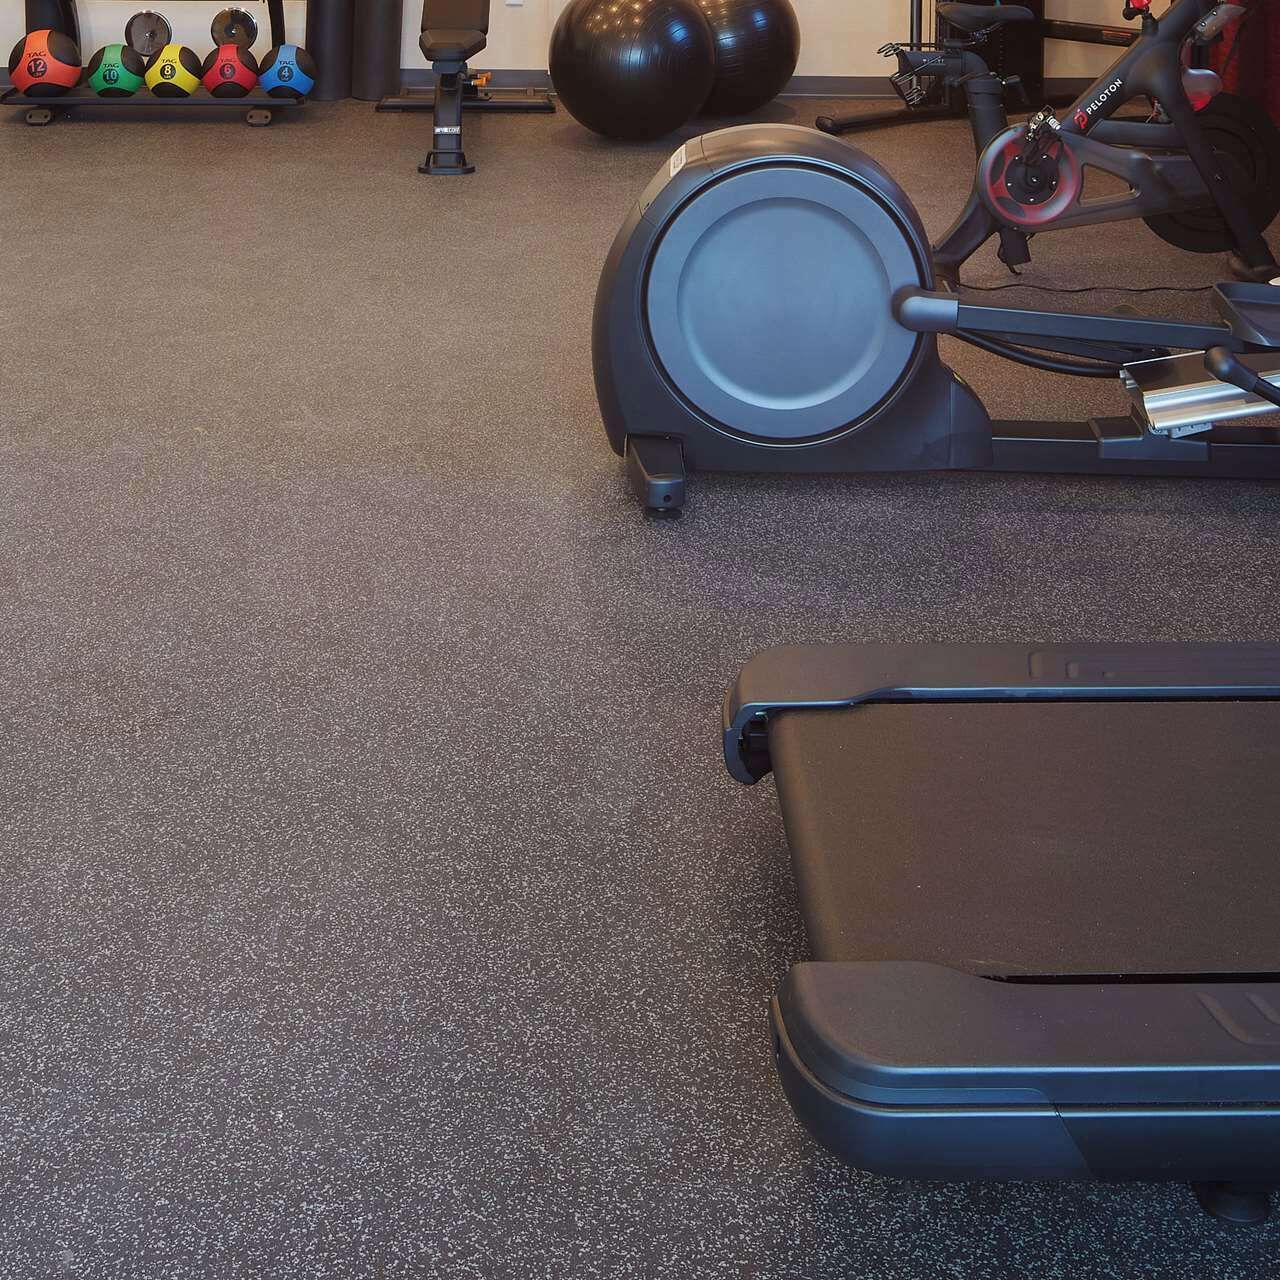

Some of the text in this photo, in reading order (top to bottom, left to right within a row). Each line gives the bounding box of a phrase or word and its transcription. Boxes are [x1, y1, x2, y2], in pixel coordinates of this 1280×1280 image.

[28, 60, 44, 73] 12
[165, 65, 171, 75] 8
[224, 63, 231, 74] 6
[104, 71, 117, 80] 10
[282, 67, 289, 77] 4
[1086, 78, 1123, 115] PELOTON
